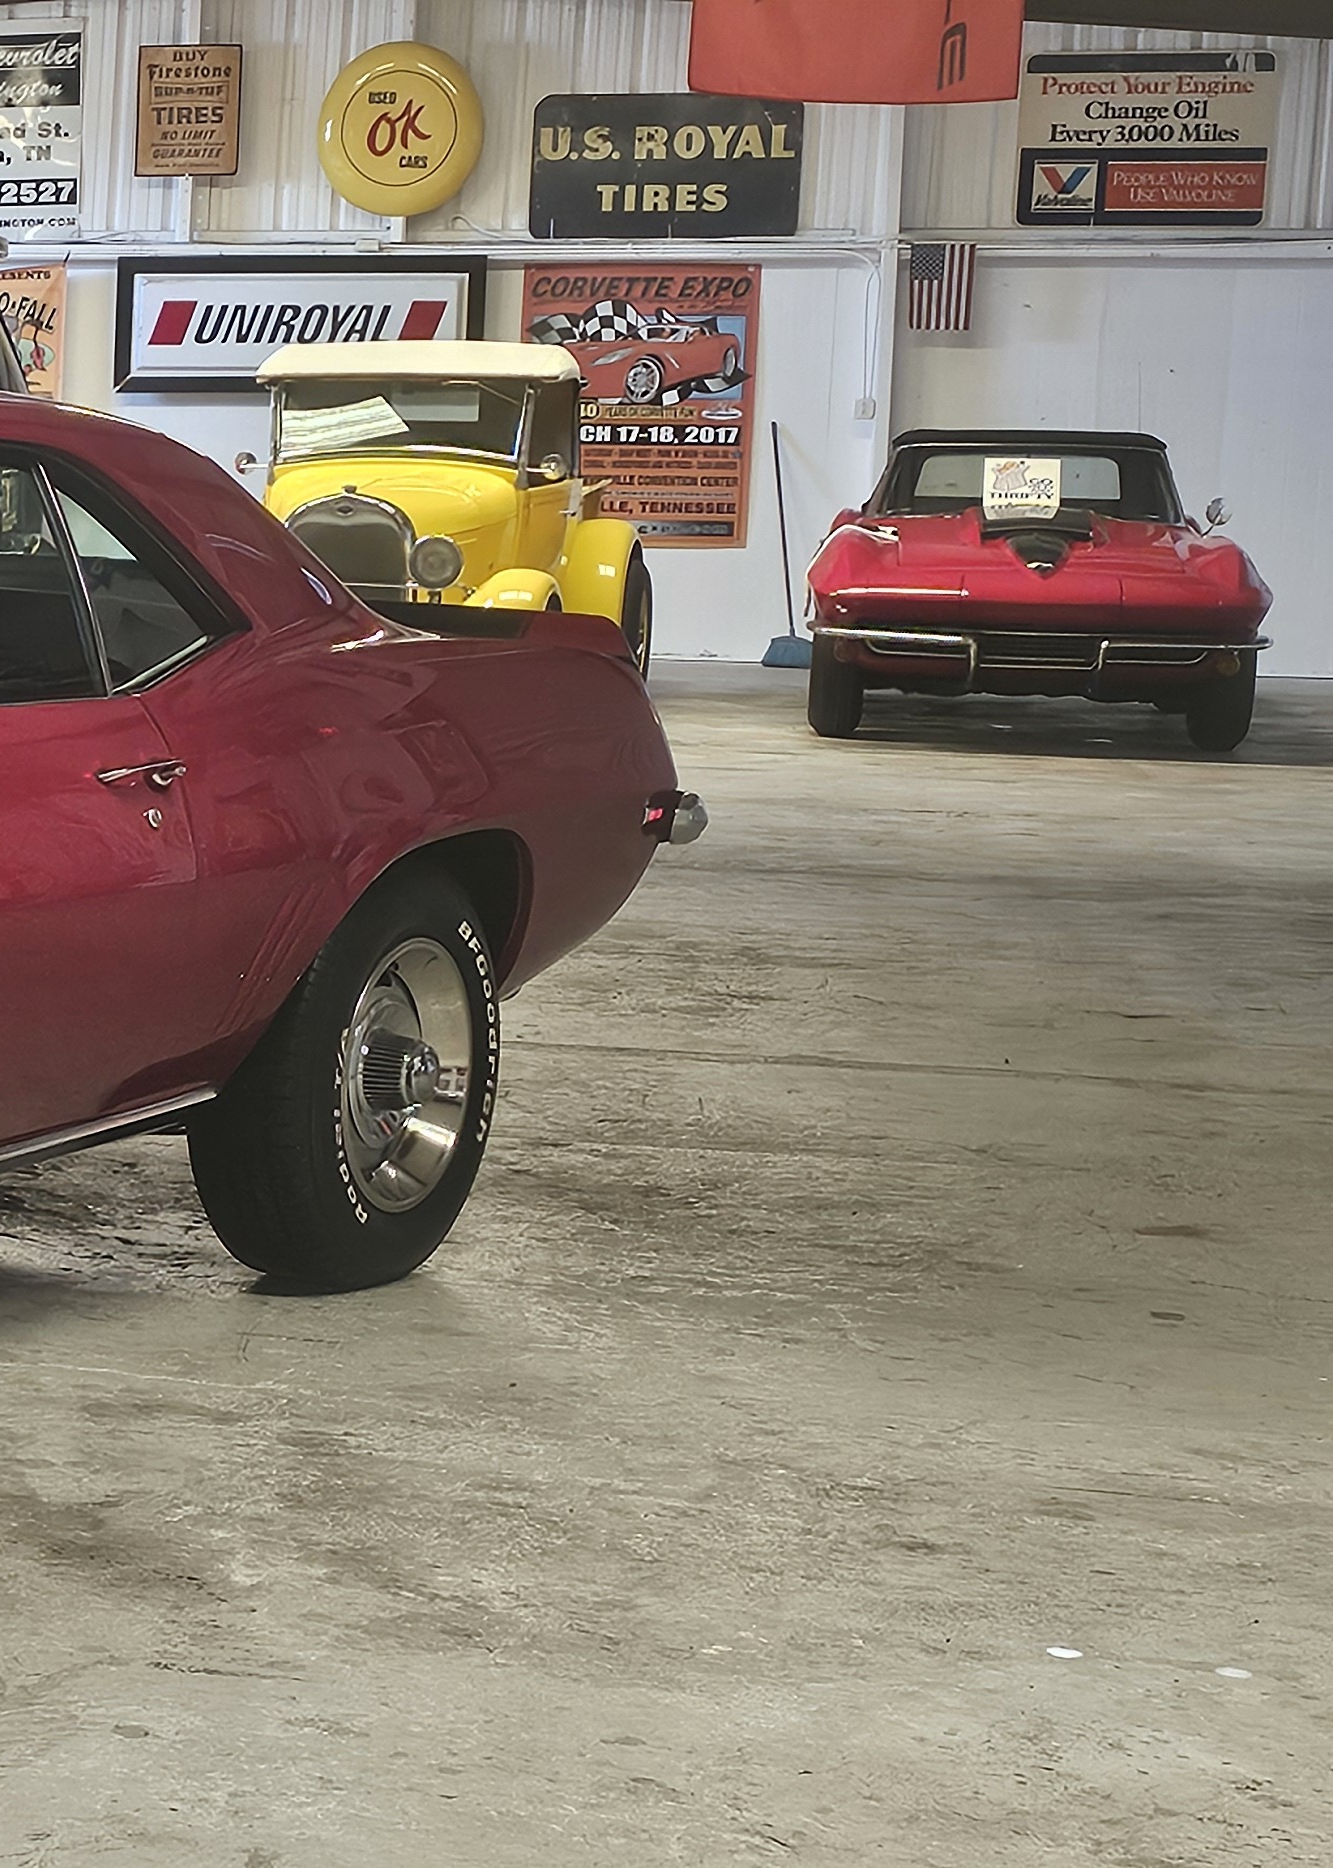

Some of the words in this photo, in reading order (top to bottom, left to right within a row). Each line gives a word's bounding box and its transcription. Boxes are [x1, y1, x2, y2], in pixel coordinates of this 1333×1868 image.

[173, 50, 209, 62] BUY
[147, 64, 232, 80] Firestone
[1041, 76, 1117, 96] Protect
[1121, 76, 1171, 95] Your
[1175, 75, 1255, 98] Engine
[368, 91, 397, 104] USED
[151, 106, 225, 125] TIRES
[1084, 99, 1169, 123] Change
[1174, 99, 1208, 120] Oil
[38, 121, 70, 138] St.
[181, 129, 217, 141] LIMIT
[366, 98, 432, 157] OK
[1049, 123, 1111, 146] Every
[1179, 122, 1240, 143] Miles
[540, 126, 620, 160] U.S.
[634, 124, 795, 160] ROYAL
[23, 146, 52, 161] TN
[399, 155, 428, 168] CARS
[1113, 171, 1168, 187] PEOPLE
[1171, 171, 1209, 186] WHO
[1212, 171, 1259, 186] KNOW
[597, 183, 728, 213] TIRES
[1130, 188, 1159, 203] USE
[1162, 188, 1237, 204] VALVOLINE
[533, 276, 675, 299] CORVETTE
[679, 276, 753, 299] EXPO
[194, 304, 393, 344] UNIROYAL
[617, 426, 679, 444] 17-18,
[685, 427, 739, 444] 2017
[639, 501, 737, 515] TENNESSEE
